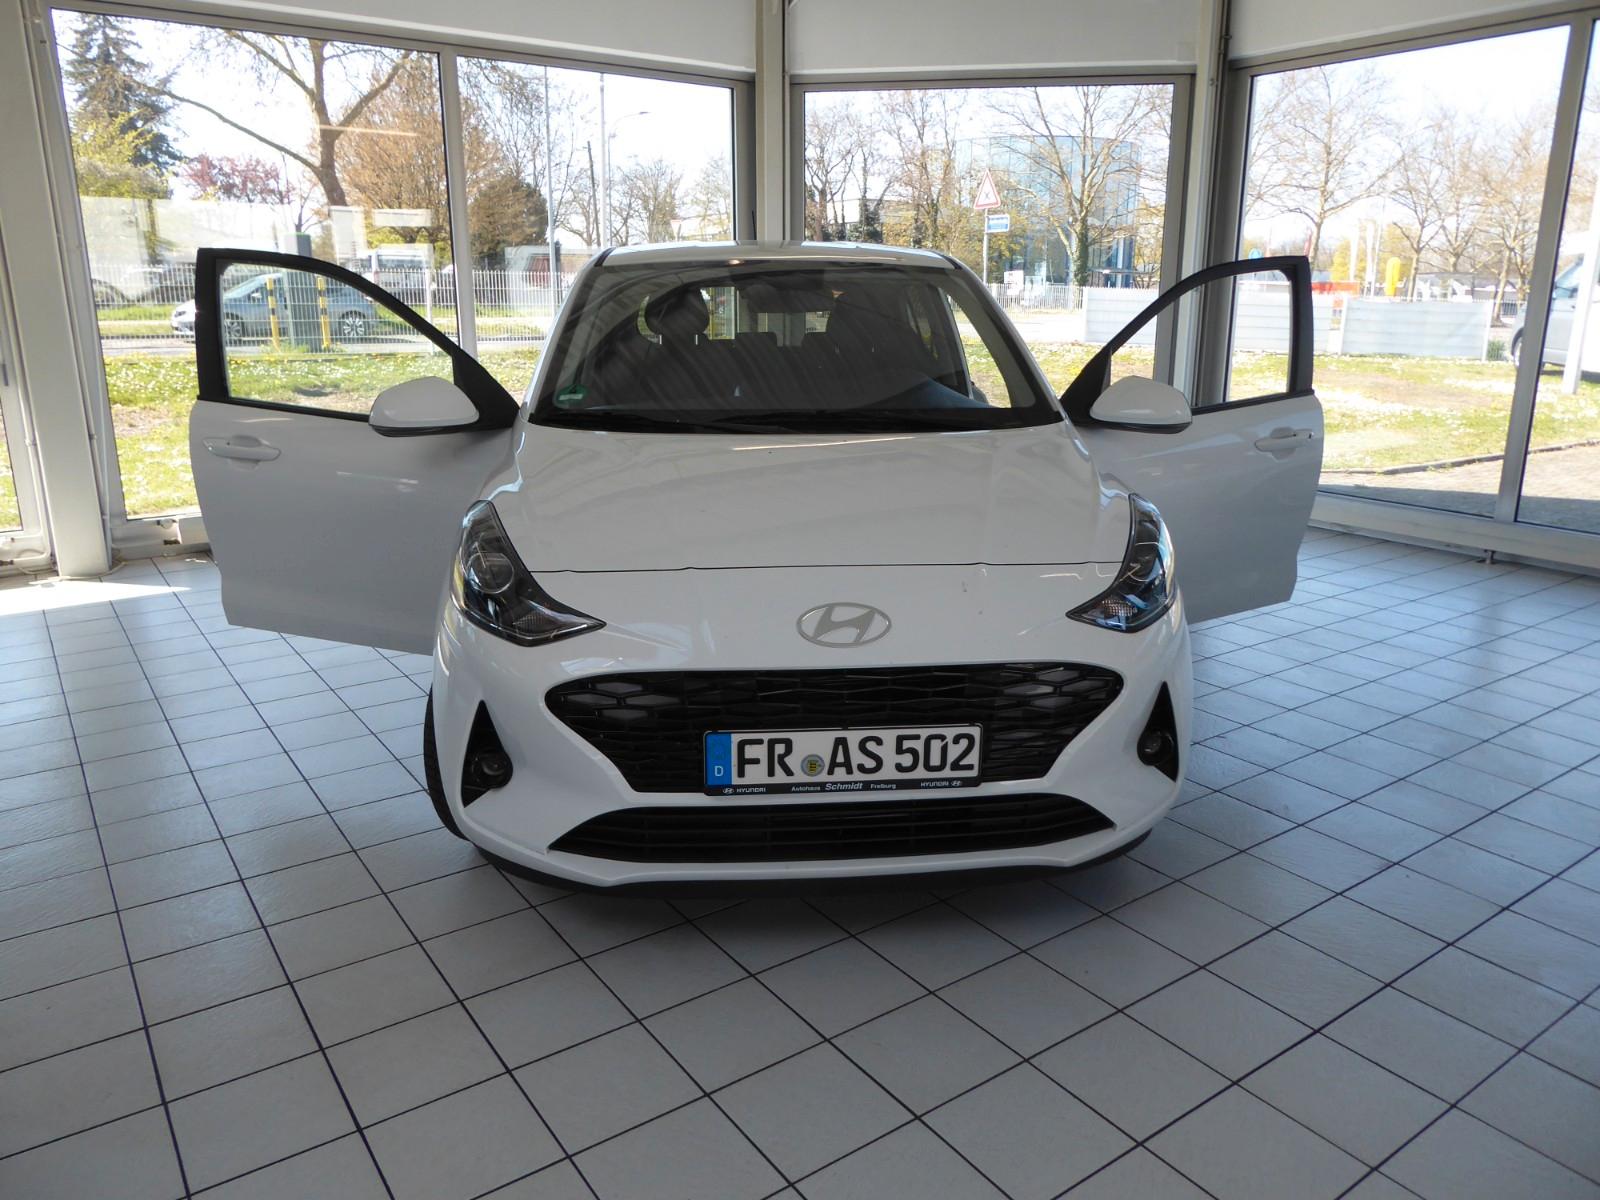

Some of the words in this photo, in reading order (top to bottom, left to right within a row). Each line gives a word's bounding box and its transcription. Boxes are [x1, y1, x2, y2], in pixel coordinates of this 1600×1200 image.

[737, 738, 795, 778] FR
[826, 735, 884, 776] AS
[894, 732, 976, 774] 502
[714, 765, 724, 777] D
[825, 782, 864, 791] Schmidt
[870, 783, 896, 791] Freiburg
